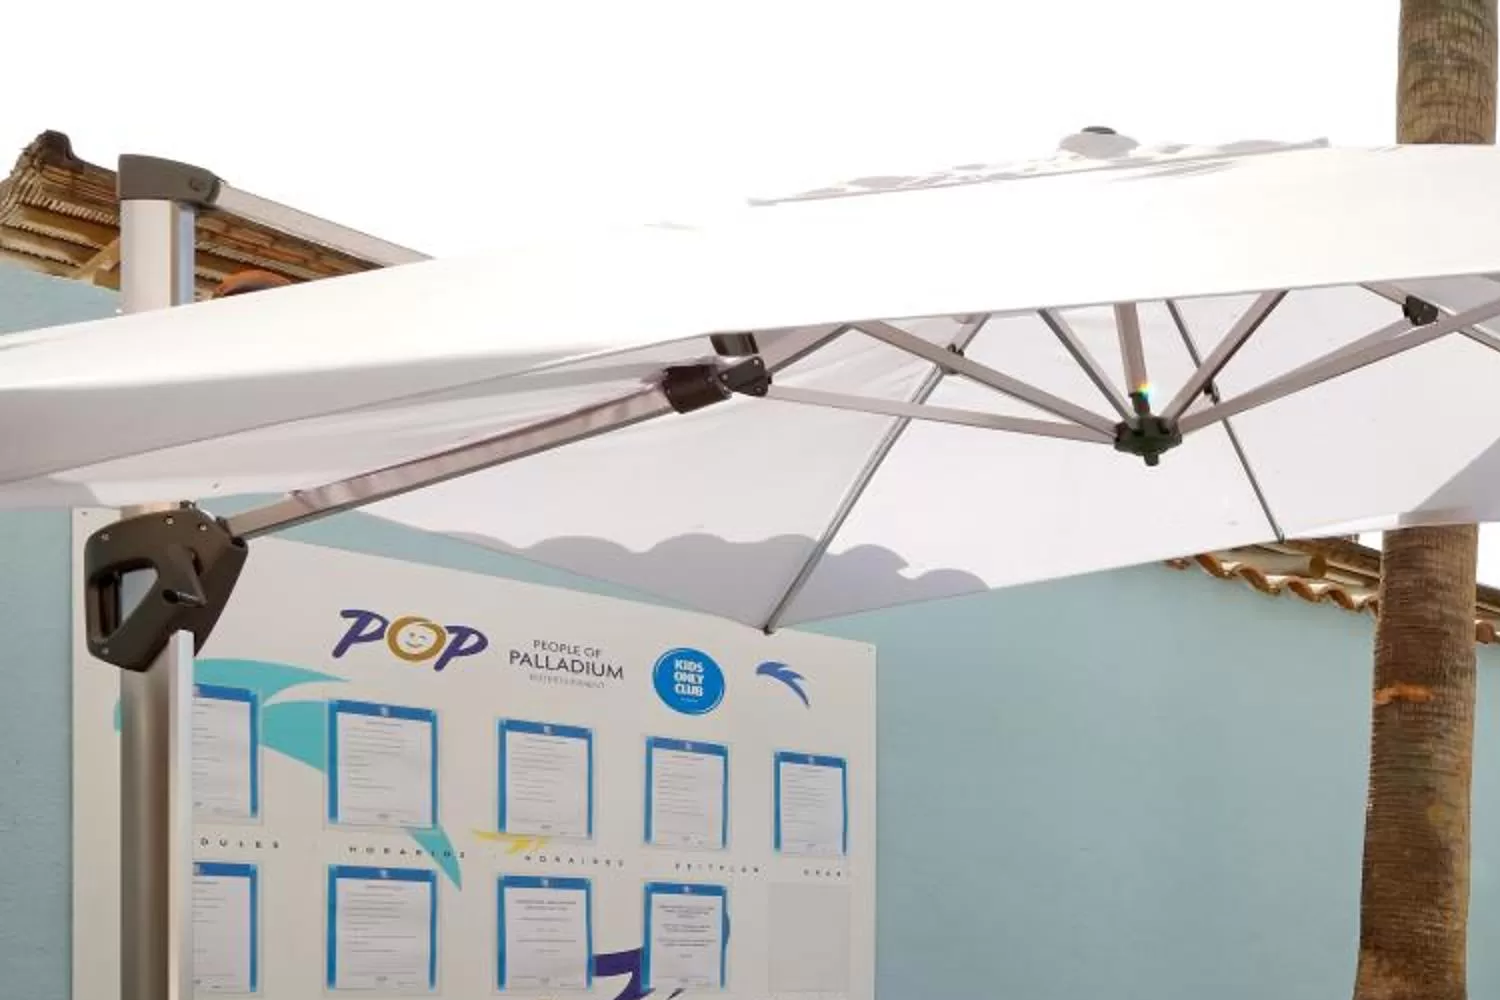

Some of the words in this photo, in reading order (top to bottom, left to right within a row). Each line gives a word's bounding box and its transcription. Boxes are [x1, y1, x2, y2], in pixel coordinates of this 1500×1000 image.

[332, 609, 489, 672] POP
[532, 639, 581, 656] PEOPLE
[583, 647, 602, 660] OF
[508, 649, 624, 680] PALLADIUM
[674, 659, 704, 673] KIDS
[673, 671, 705, 685] ONLY
[674, 683, 704, 697] CLUB
[200, 836, 279, 850] DULES
